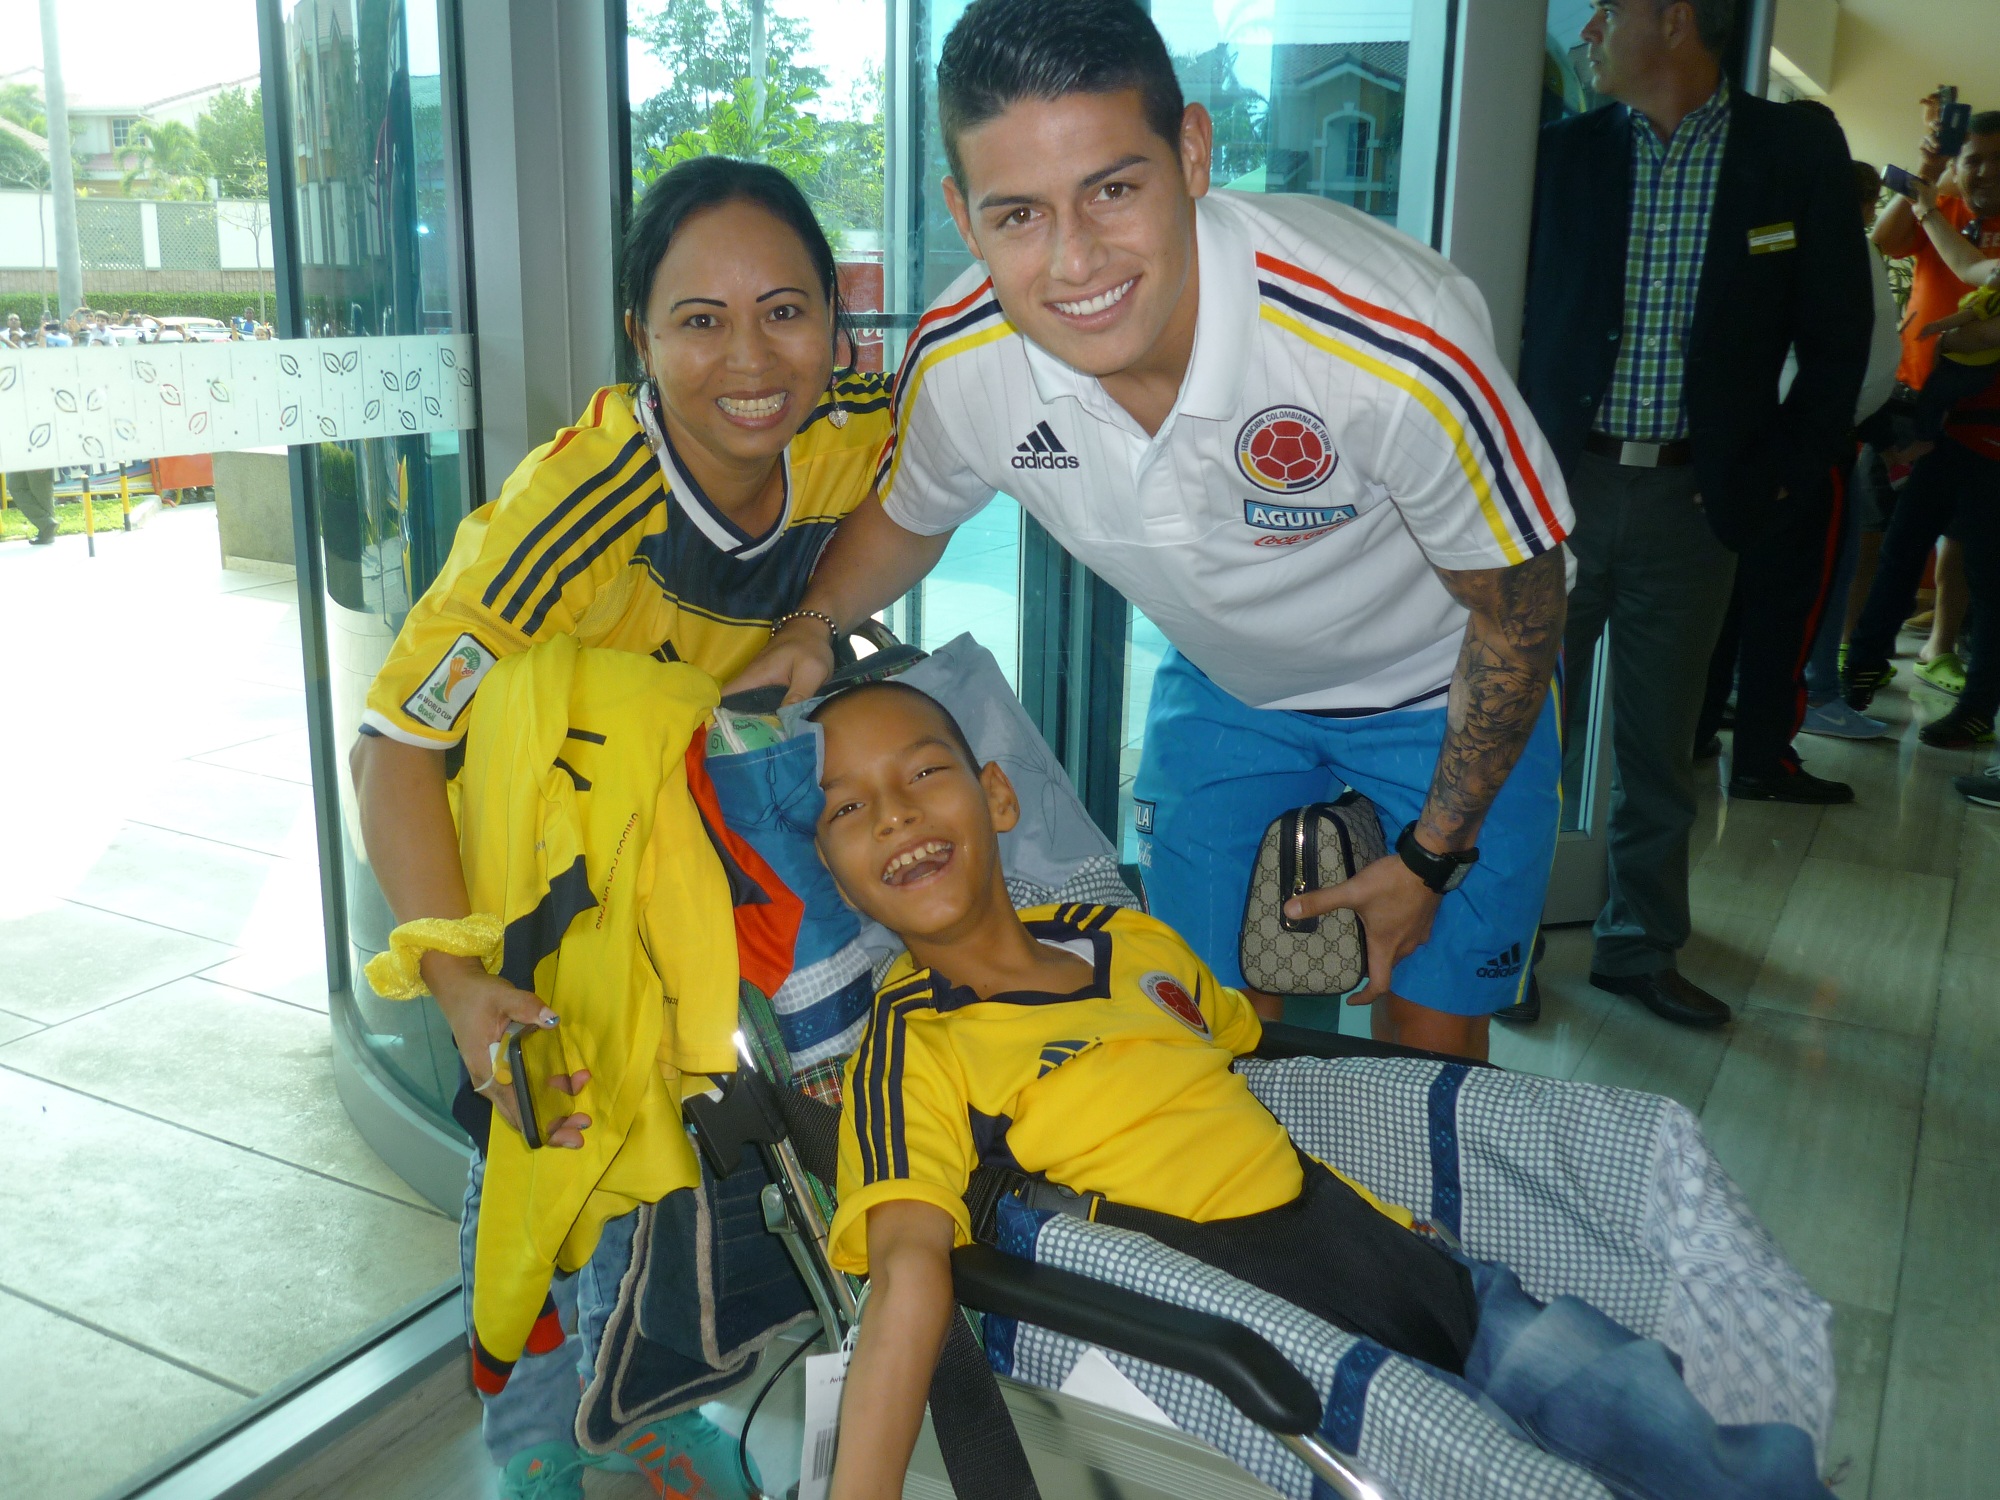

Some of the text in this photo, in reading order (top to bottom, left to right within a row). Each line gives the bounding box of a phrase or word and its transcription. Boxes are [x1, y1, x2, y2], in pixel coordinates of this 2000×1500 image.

[1241, 410, 1332, 452] FEDERACION COLOMBIANA DE FUTBOL
[1011, 451, 1080, 469] adidas
[1252, 507, 1351, 527] AGUILA
[417, 704, 437, 721] Brasil
[423, 695, 442, 714] WORLD
[441, 710, 453, 721] CUP
